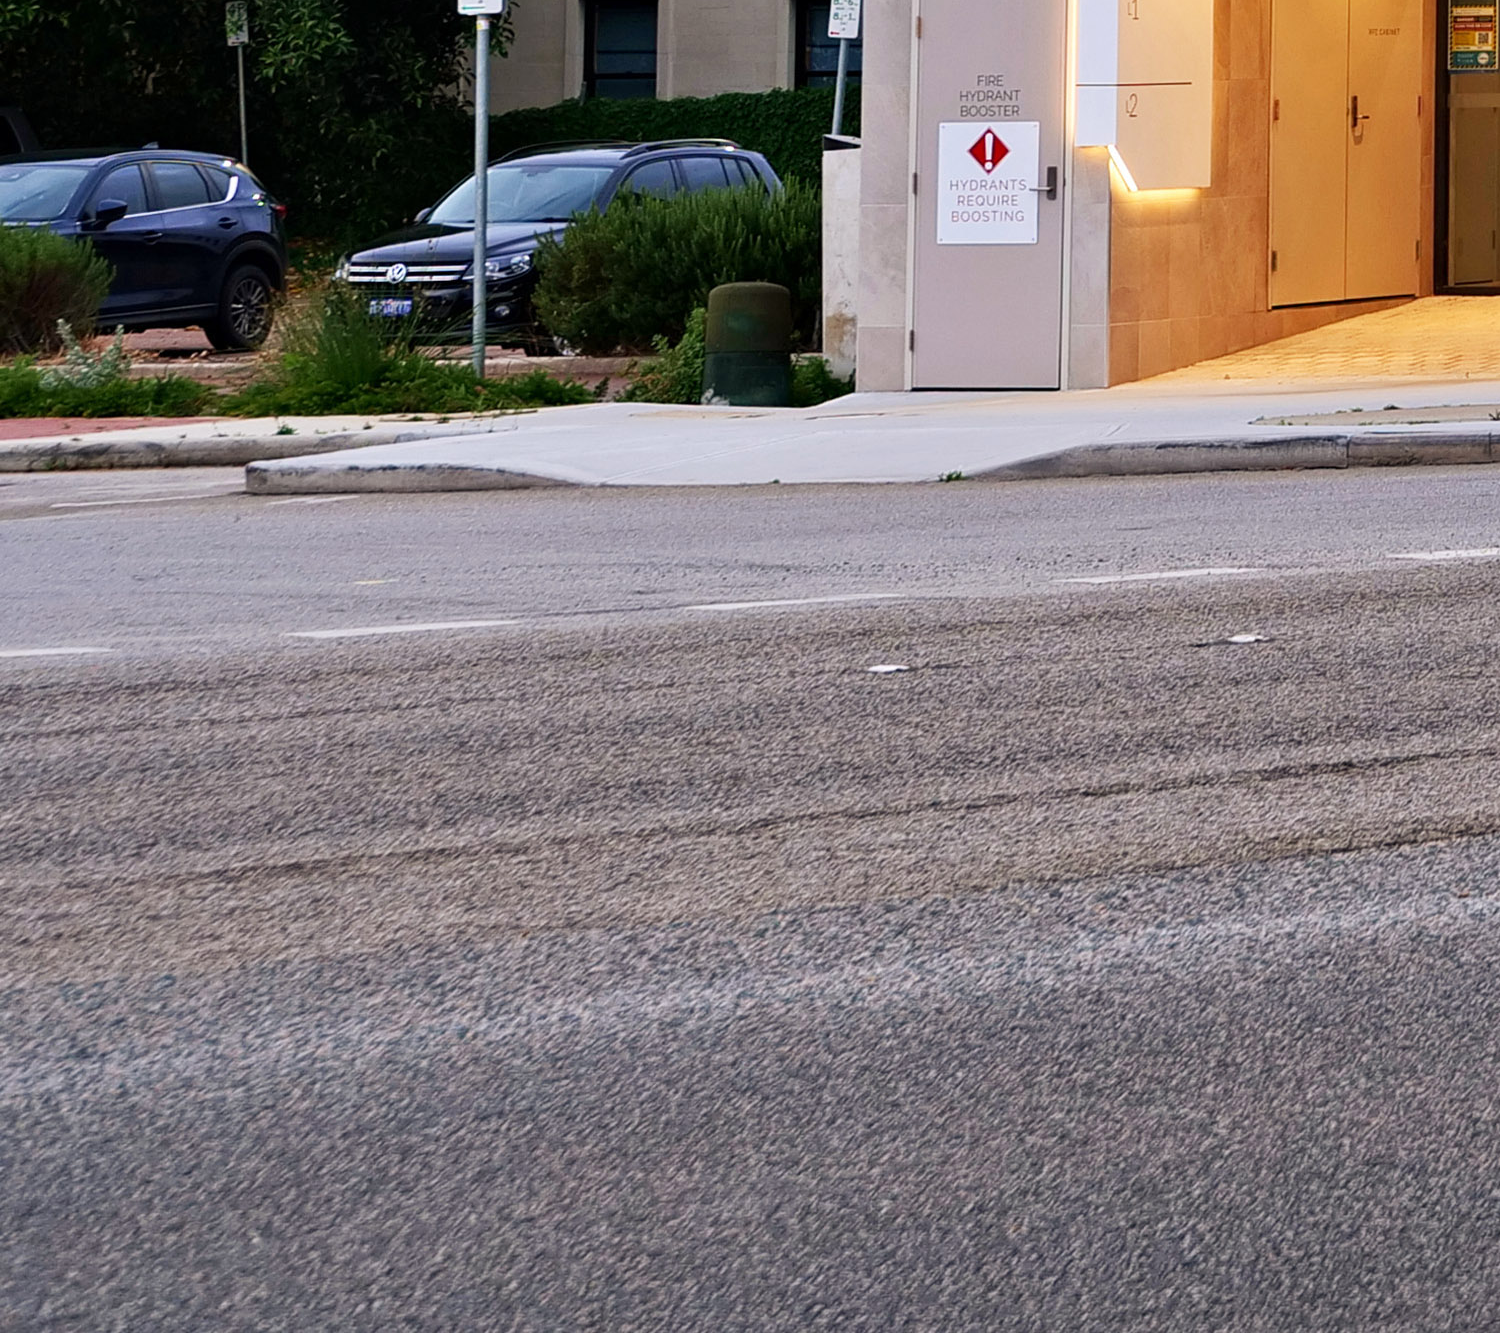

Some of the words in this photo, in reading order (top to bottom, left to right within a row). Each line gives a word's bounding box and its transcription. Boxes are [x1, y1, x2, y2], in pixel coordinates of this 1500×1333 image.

[977, 74, 1004, 86] FIRE
[959, 90, 1021, 102] HYDRANT
[960, 105, 1020, 117] BOOSTER
[950, 179, 1027, 191] HYDRANTS
[957, 195, 1018, 206] REQUIRE
[951, 210, 1025, 222] BOOSTING
